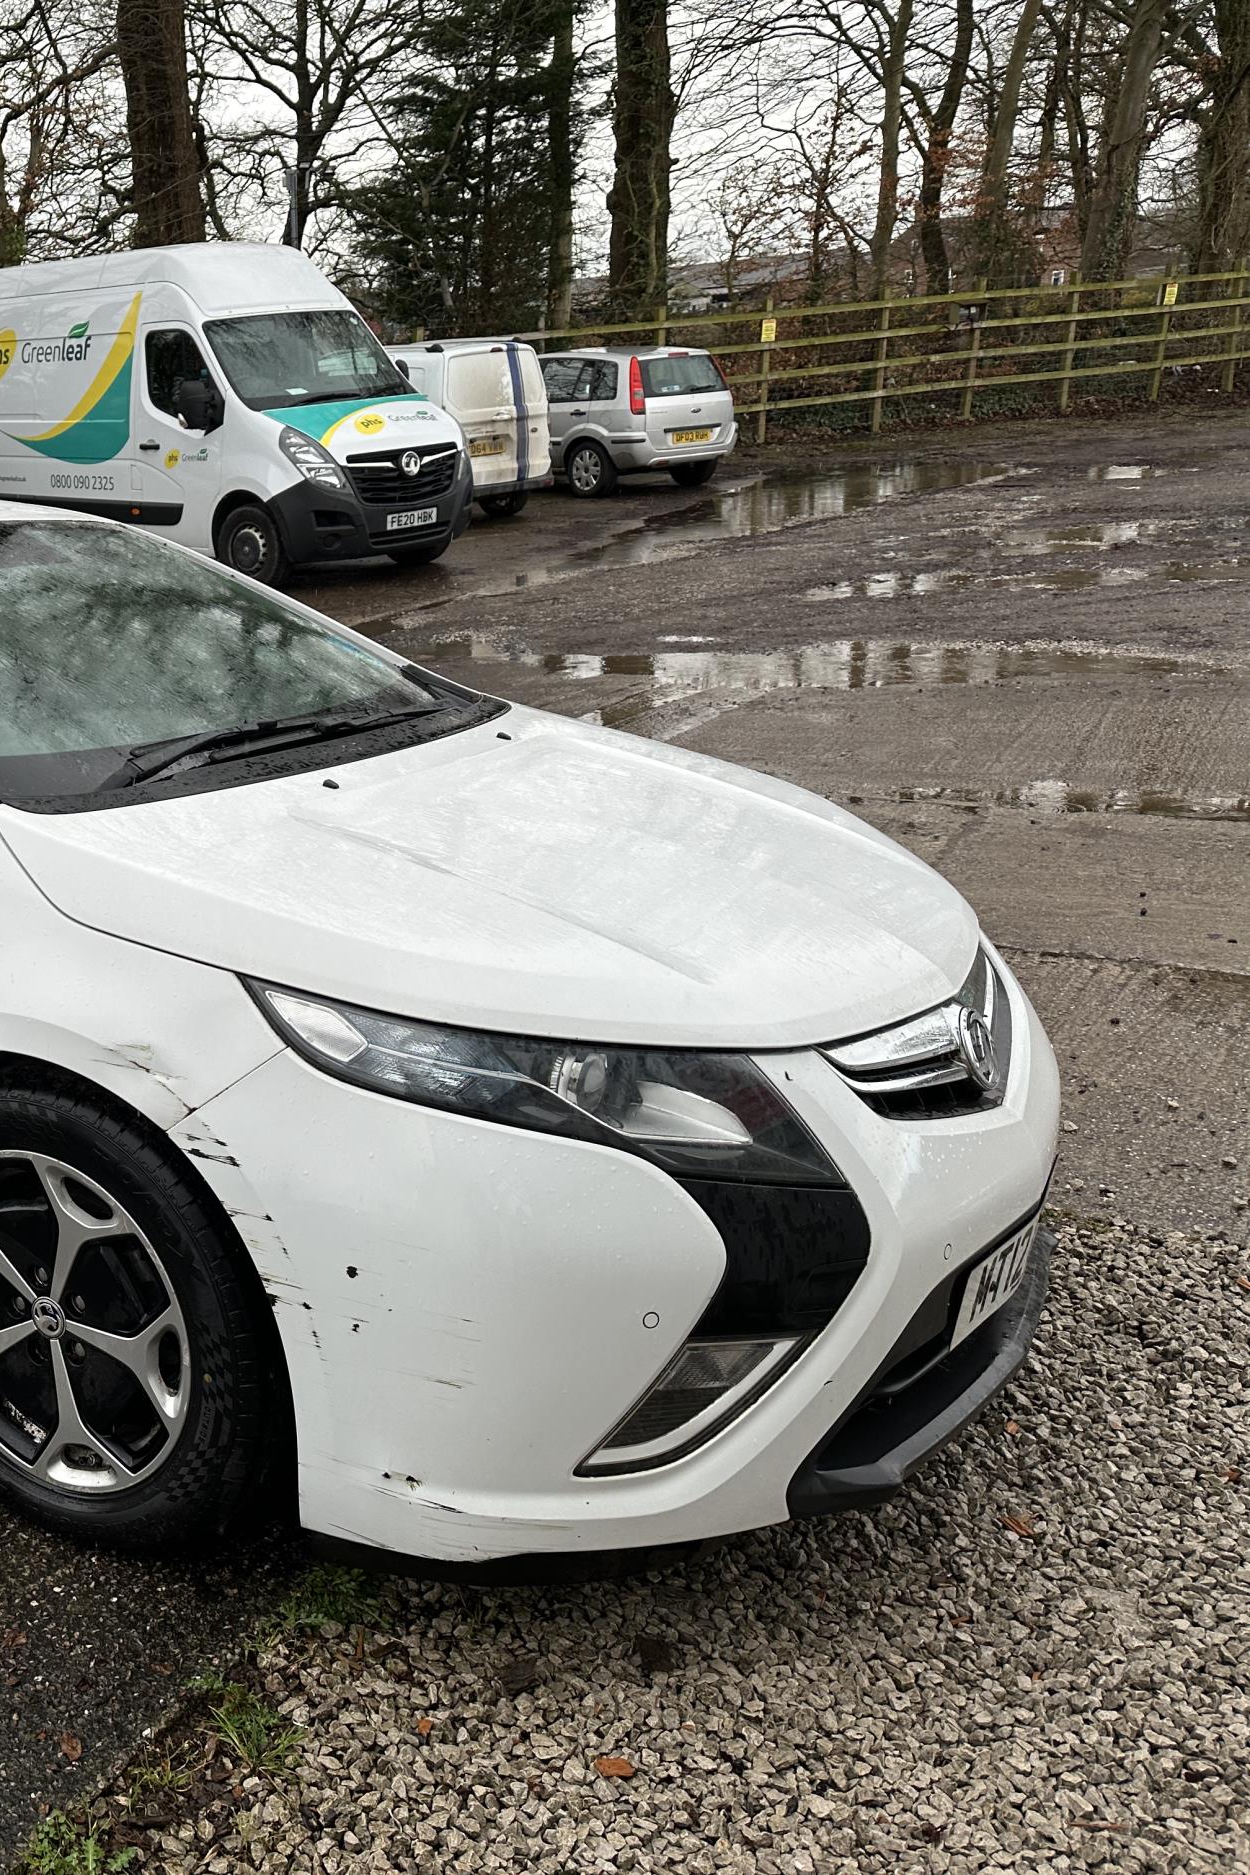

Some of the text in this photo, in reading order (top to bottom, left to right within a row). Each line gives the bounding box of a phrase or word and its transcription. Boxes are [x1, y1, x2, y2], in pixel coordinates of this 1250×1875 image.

[21, 335, 93, 363] Greenleaf
[360, 418, 383, 428] phs
[168, 453, 179, 463] phs
[50, 474, 115, 491] 0800 090 2325
[390, 511, 434, 528] FE20 HBK
